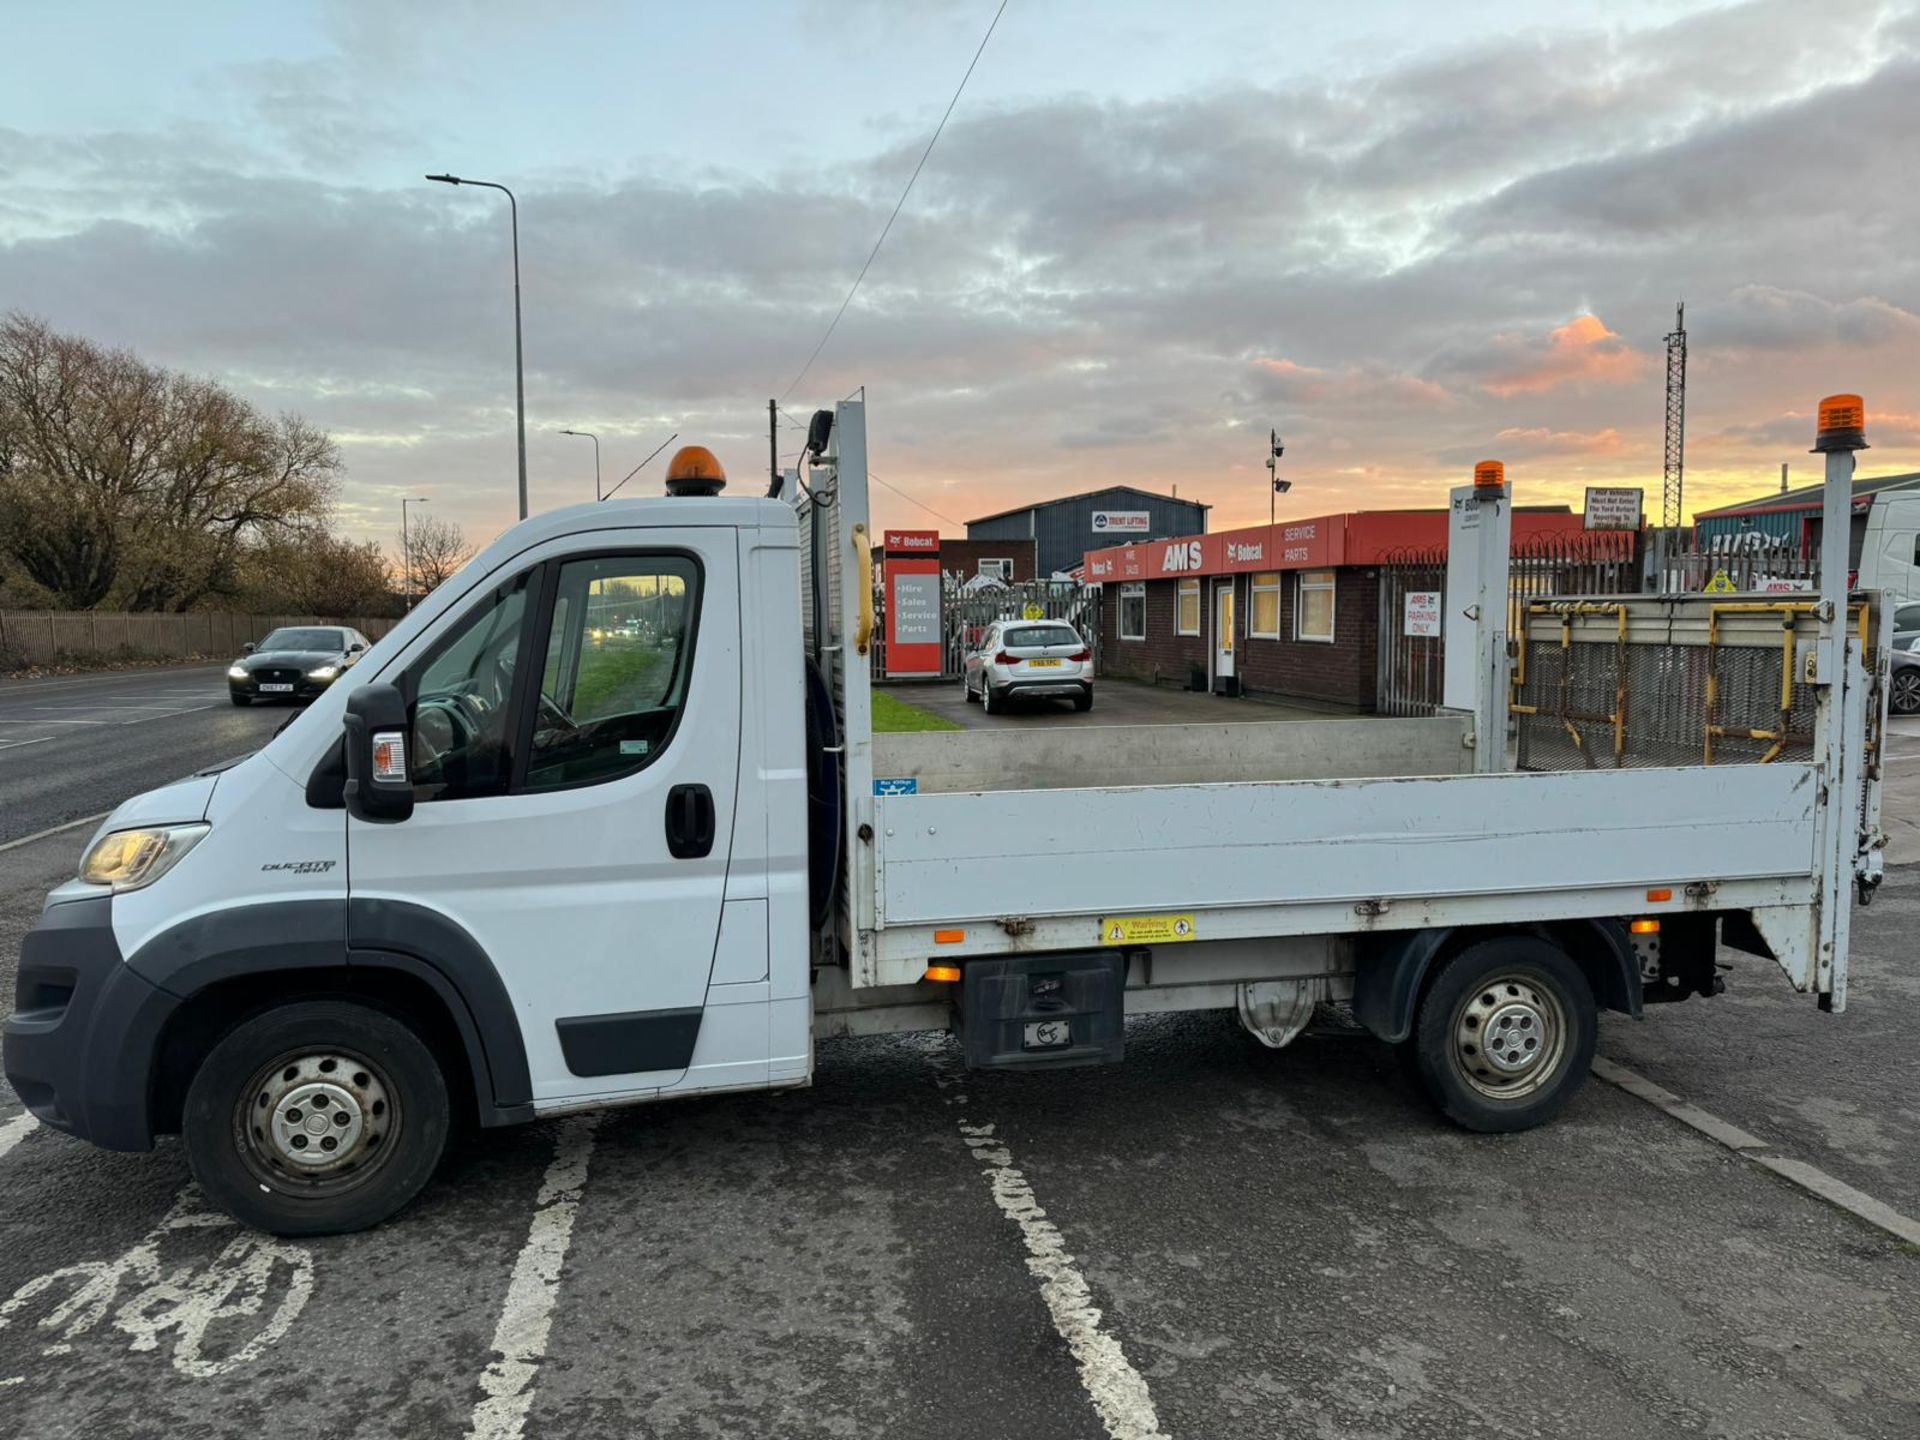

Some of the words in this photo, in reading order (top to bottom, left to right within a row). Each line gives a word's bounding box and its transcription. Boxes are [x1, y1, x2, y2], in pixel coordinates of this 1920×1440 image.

[1284, 525, 1316, 541] SERVICE
[903, 536, 933, 547] Bobcat
[1162, 541, 1203, 572] AMS
[1237, 542, 1262, 561] Bobcat
[1284, 547, 1308, 561] PARTS
[901, 584, 922, 593] Hire
[902, 598, 926, 606] Sales
[902, 611, 937, 620] Service
[1408, 610, 1436, 621] PARKING
[902, 624, 927, 633] Parts
[1412, 622, 1429, 633] ONLY
[261, 861, 336, 871] DUCATO
[1132, 920, 1167, 929] Warning
